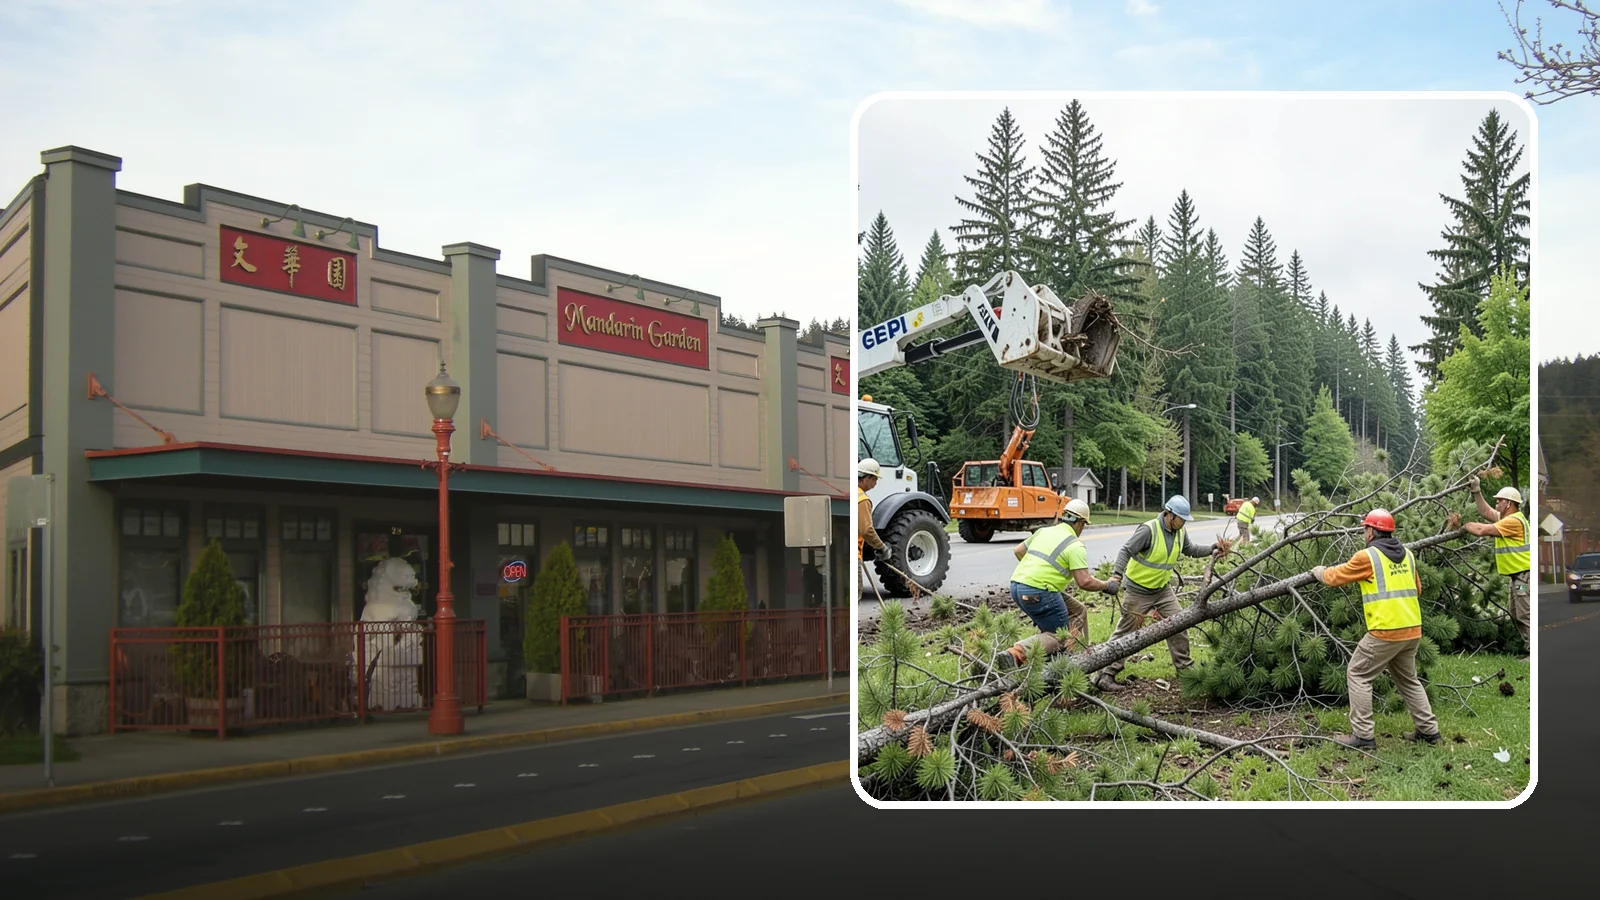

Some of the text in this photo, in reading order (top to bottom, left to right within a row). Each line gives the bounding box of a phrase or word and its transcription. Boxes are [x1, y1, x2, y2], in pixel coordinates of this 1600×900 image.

[564, 301, 702, 353] Mandarin Garden
[862, 315, 908, 350] GEPI
[503, 565, 527, 578] OPEN
